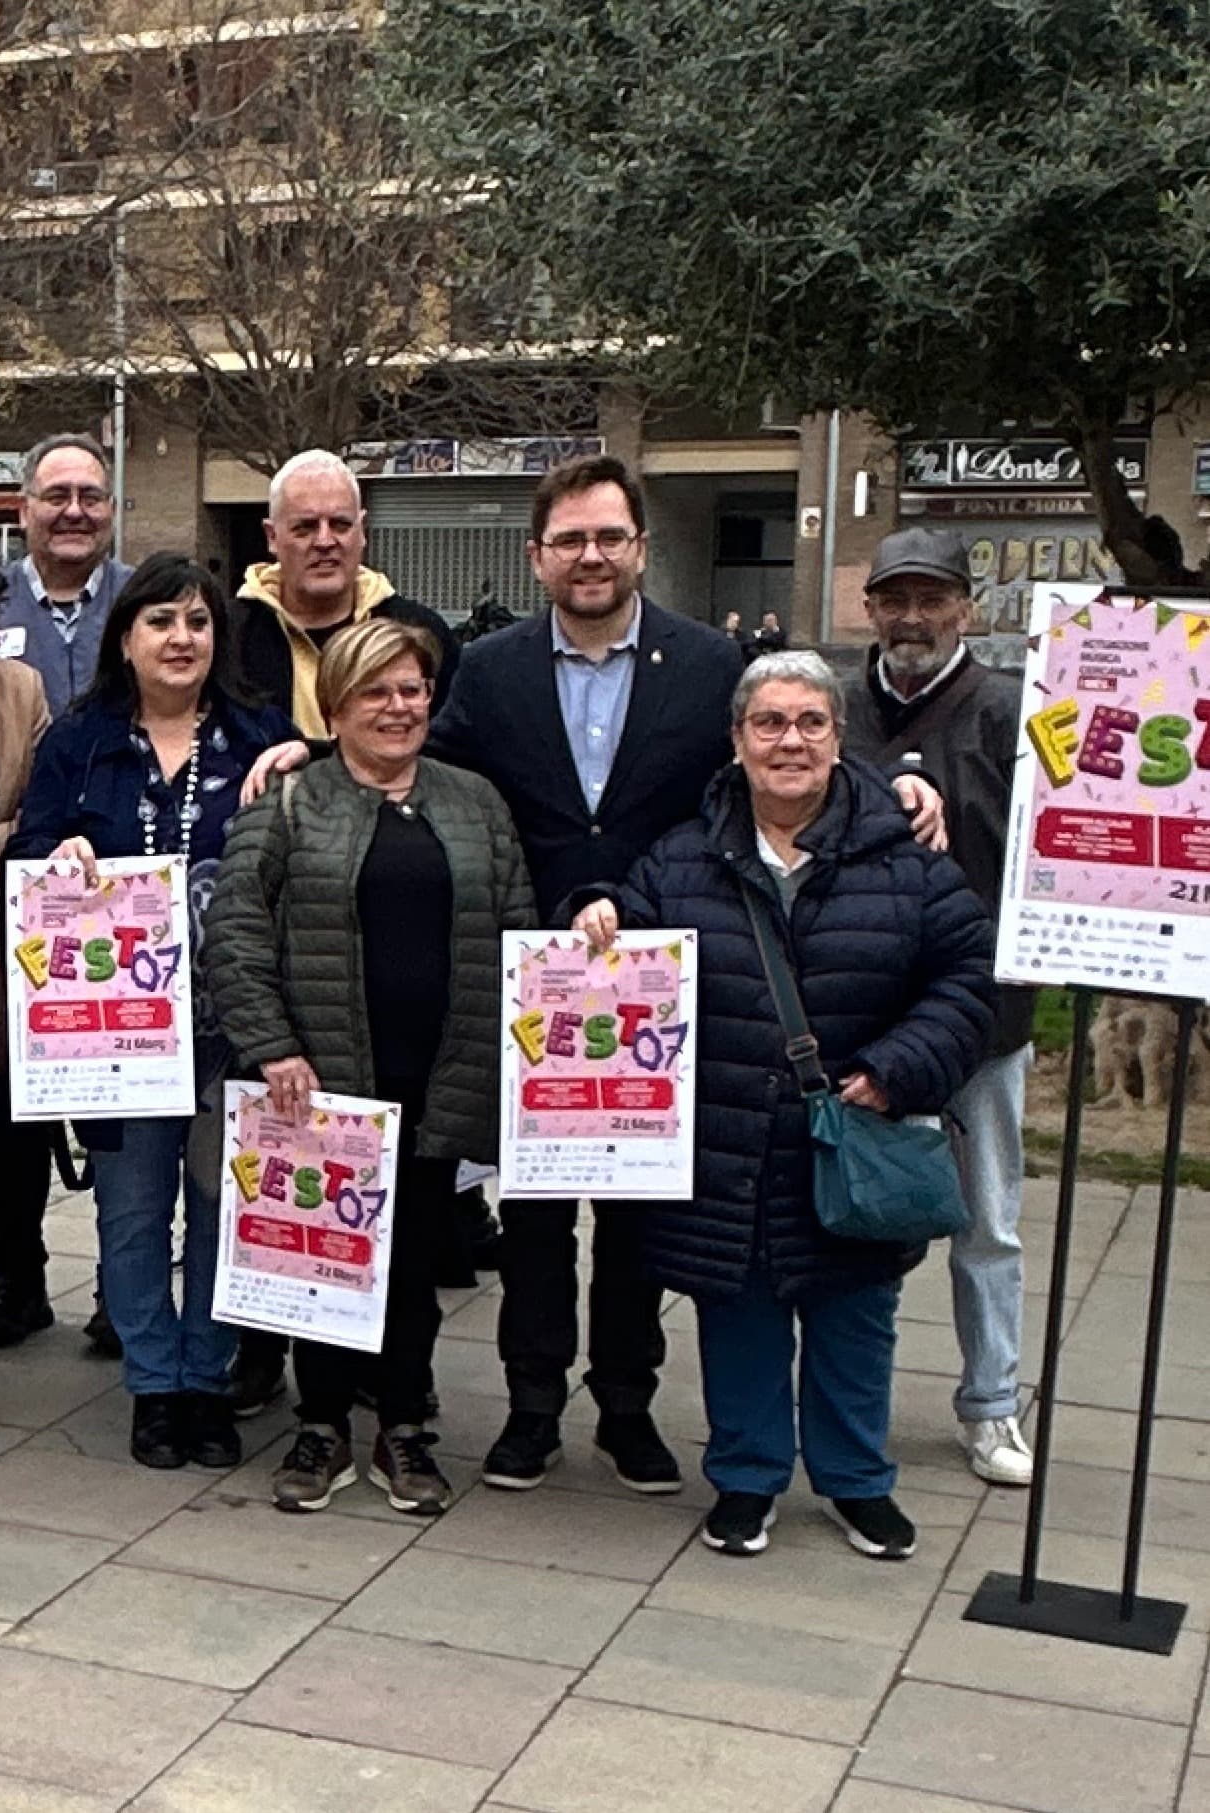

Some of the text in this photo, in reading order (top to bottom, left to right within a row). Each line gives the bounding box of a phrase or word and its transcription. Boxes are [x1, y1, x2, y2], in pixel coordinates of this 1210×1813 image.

[1169, 880, 1200, 902] 21
[14, 925, 182, 992] FEST 07
[113, 1037, 132, 1050] 21
[509, 1003, 689, 1072] FEST 07
[610, 1116, 630, 1130] 21
[229, 1148, 388, 1230] FEST 07
[313, 1262, 332, 1278] 21
